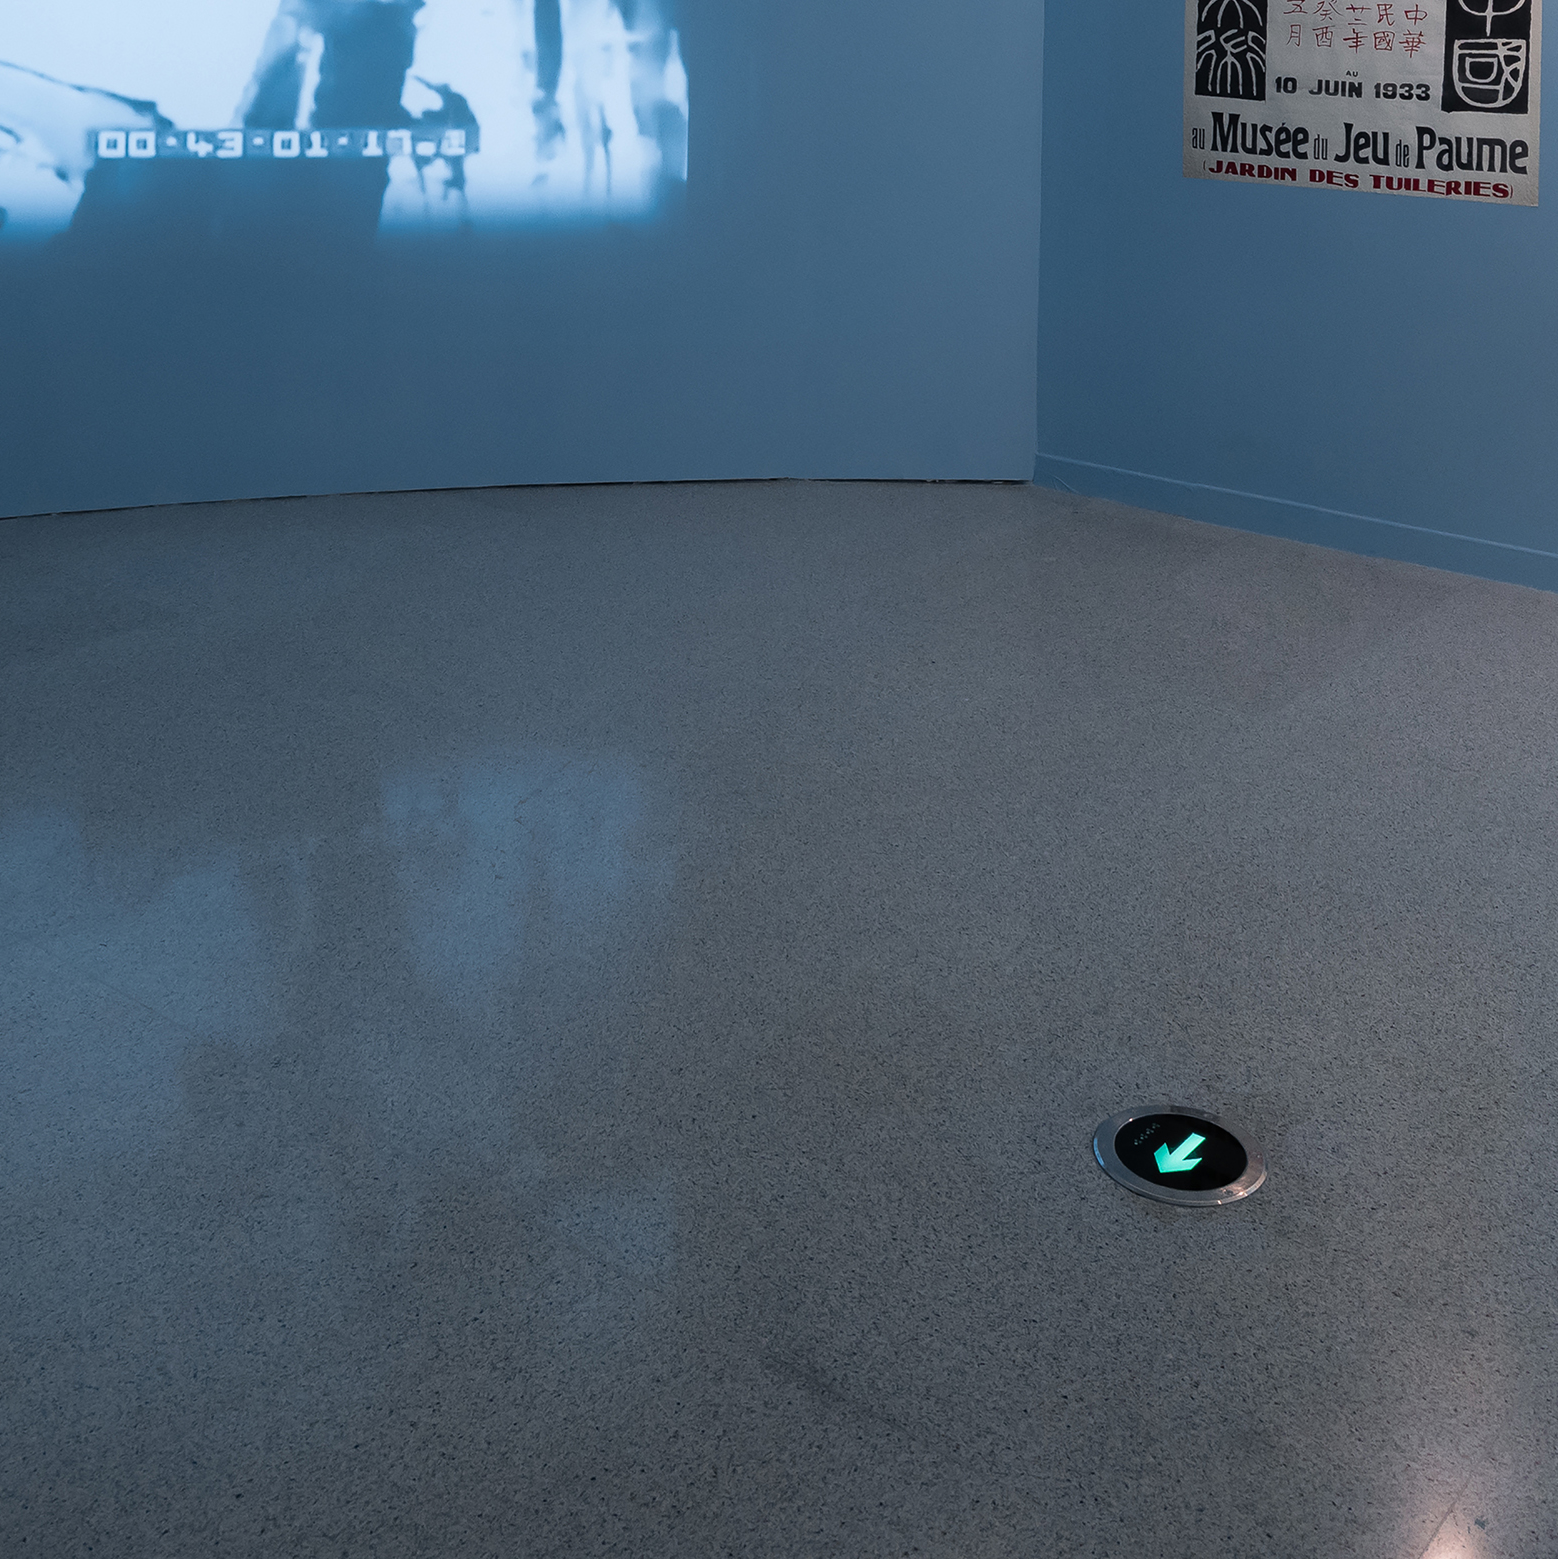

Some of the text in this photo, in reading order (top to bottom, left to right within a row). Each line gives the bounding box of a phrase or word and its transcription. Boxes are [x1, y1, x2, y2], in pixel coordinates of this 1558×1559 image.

[1275, 76, 1431, 101] 10 JUIN 1933
[1192, 112, 1529, 175] au Musée du Jeu de Paume
[1309, 168, 1359, 189] DES
